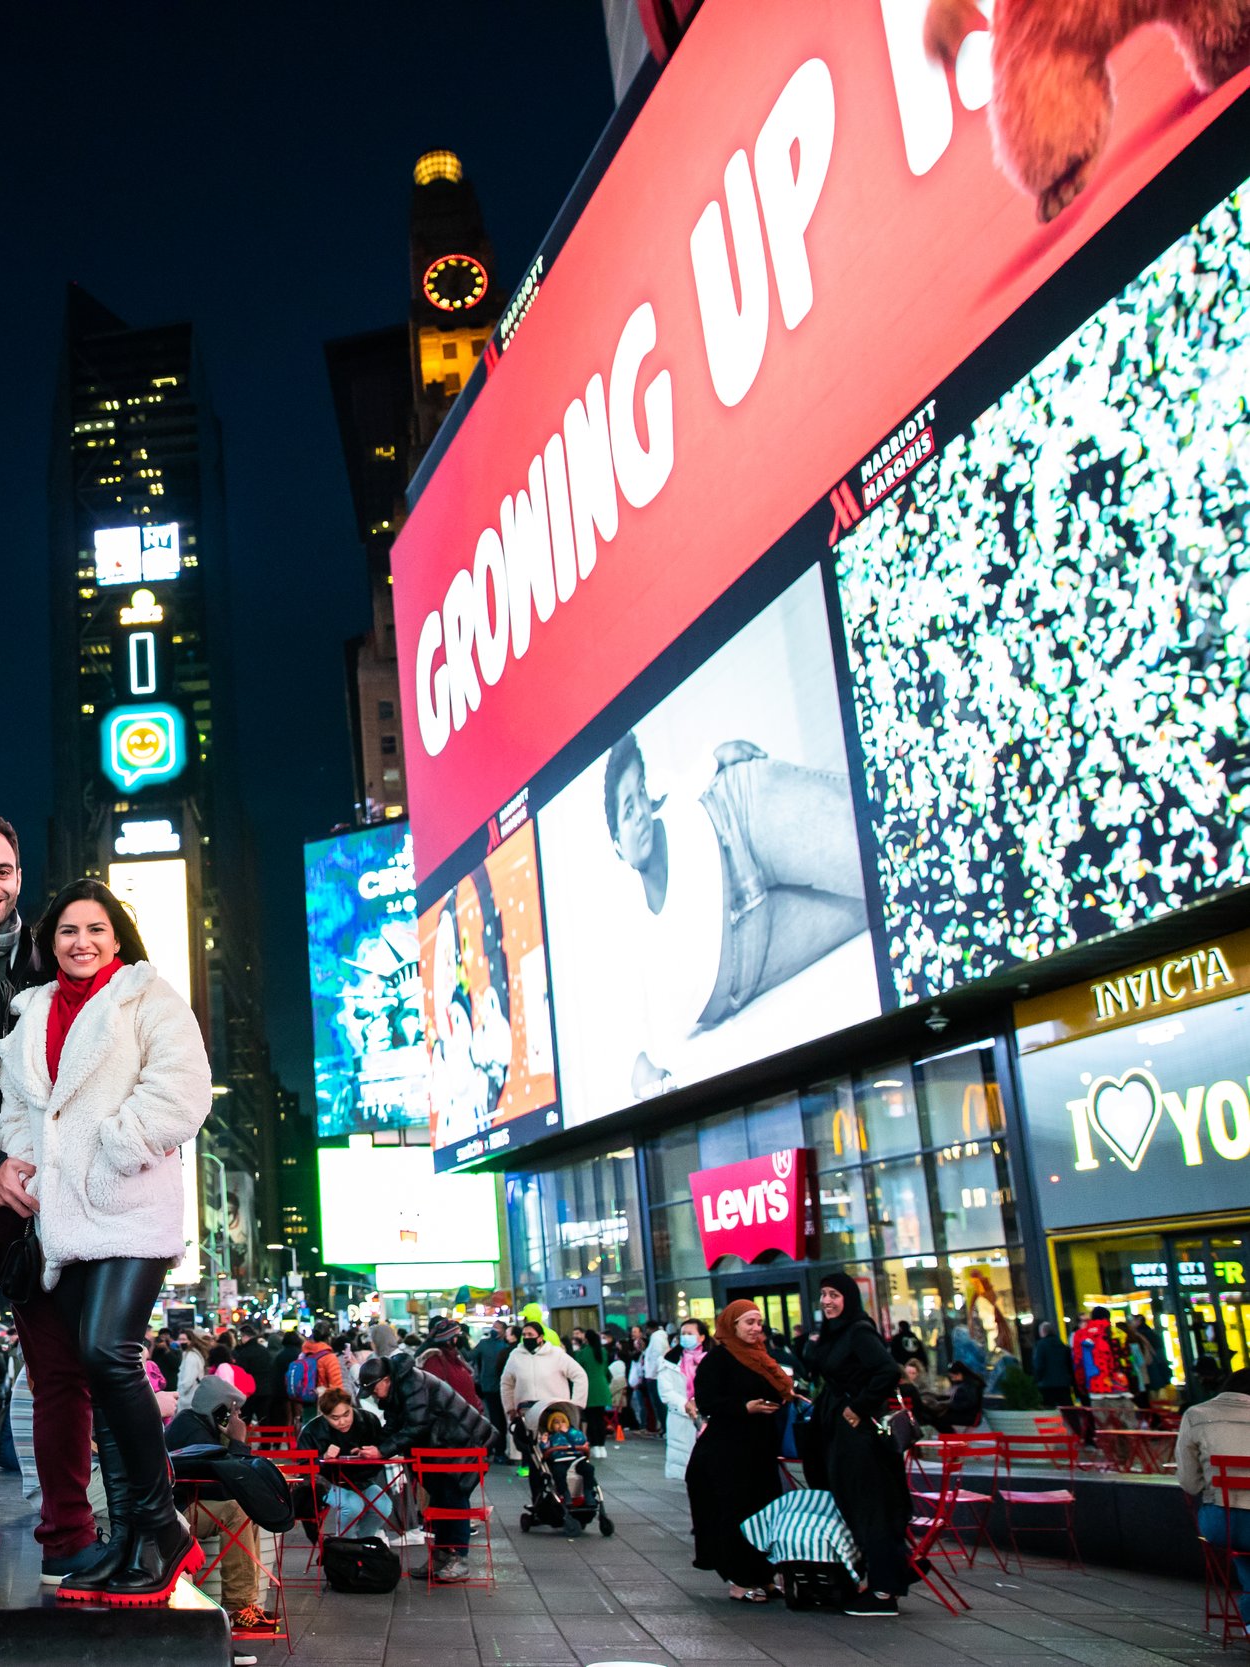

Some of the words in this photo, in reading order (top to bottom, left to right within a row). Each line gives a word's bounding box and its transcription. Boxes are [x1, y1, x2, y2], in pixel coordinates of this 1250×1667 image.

[416, 302, 674, 757] GROWING
[690, 57, 836, 406] UP
[861, 399, 936, 483] MARRIOTT
[864, 433, 932, 506] MARQUIS
[1091, 947, 1235, 1021] INVICTA
[1161, 1075, 1250, 1167] YO
